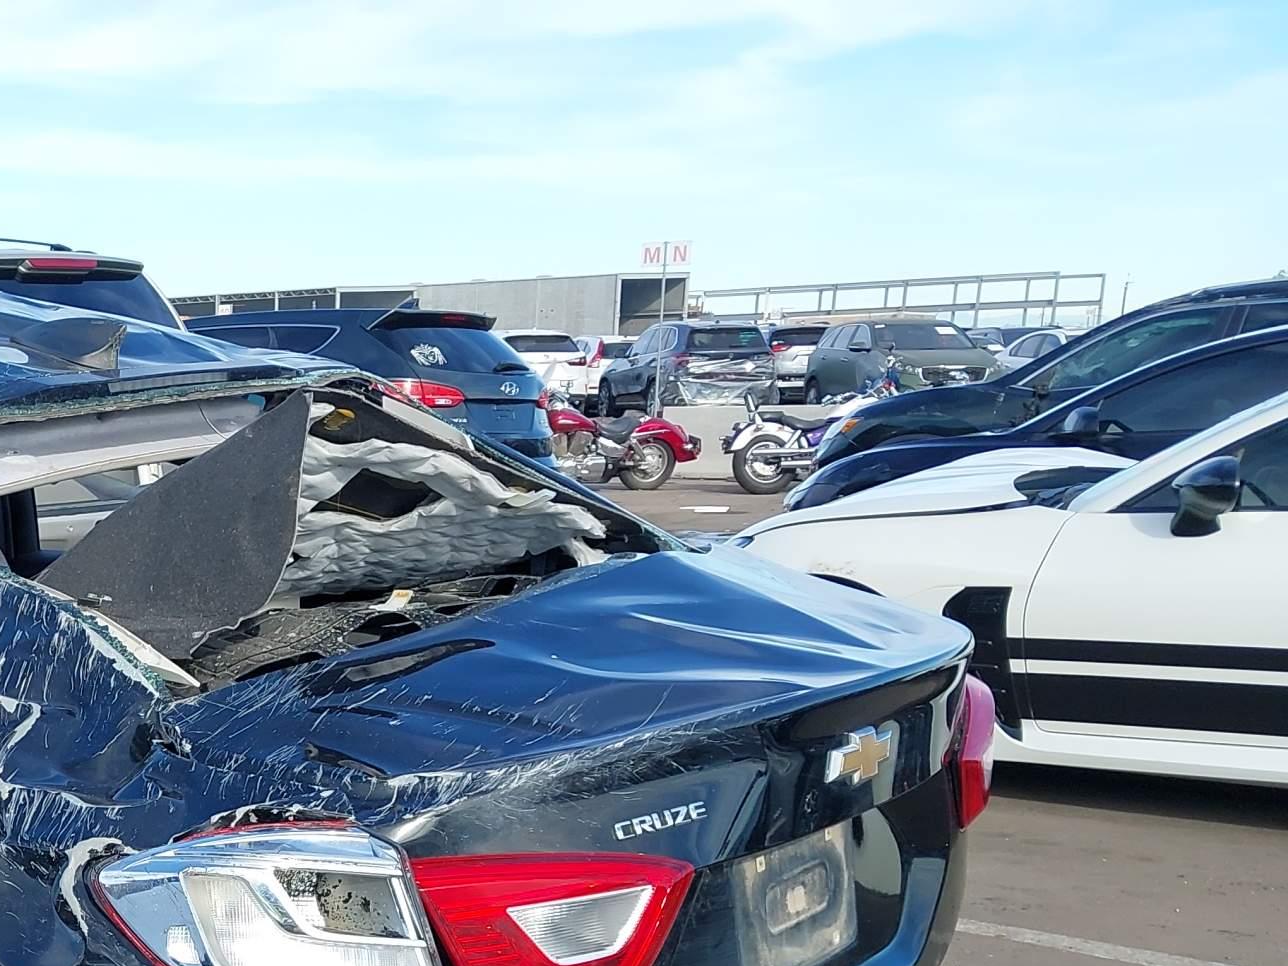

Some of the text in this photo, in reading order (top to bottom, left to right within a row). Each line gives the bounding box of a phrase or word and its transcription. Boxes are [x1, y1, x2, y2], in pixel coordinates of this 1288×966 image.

[643, 246, 661, 264] M
[673, 244, 687, 262] N
[614, 801, 708, 840] CRUZE
